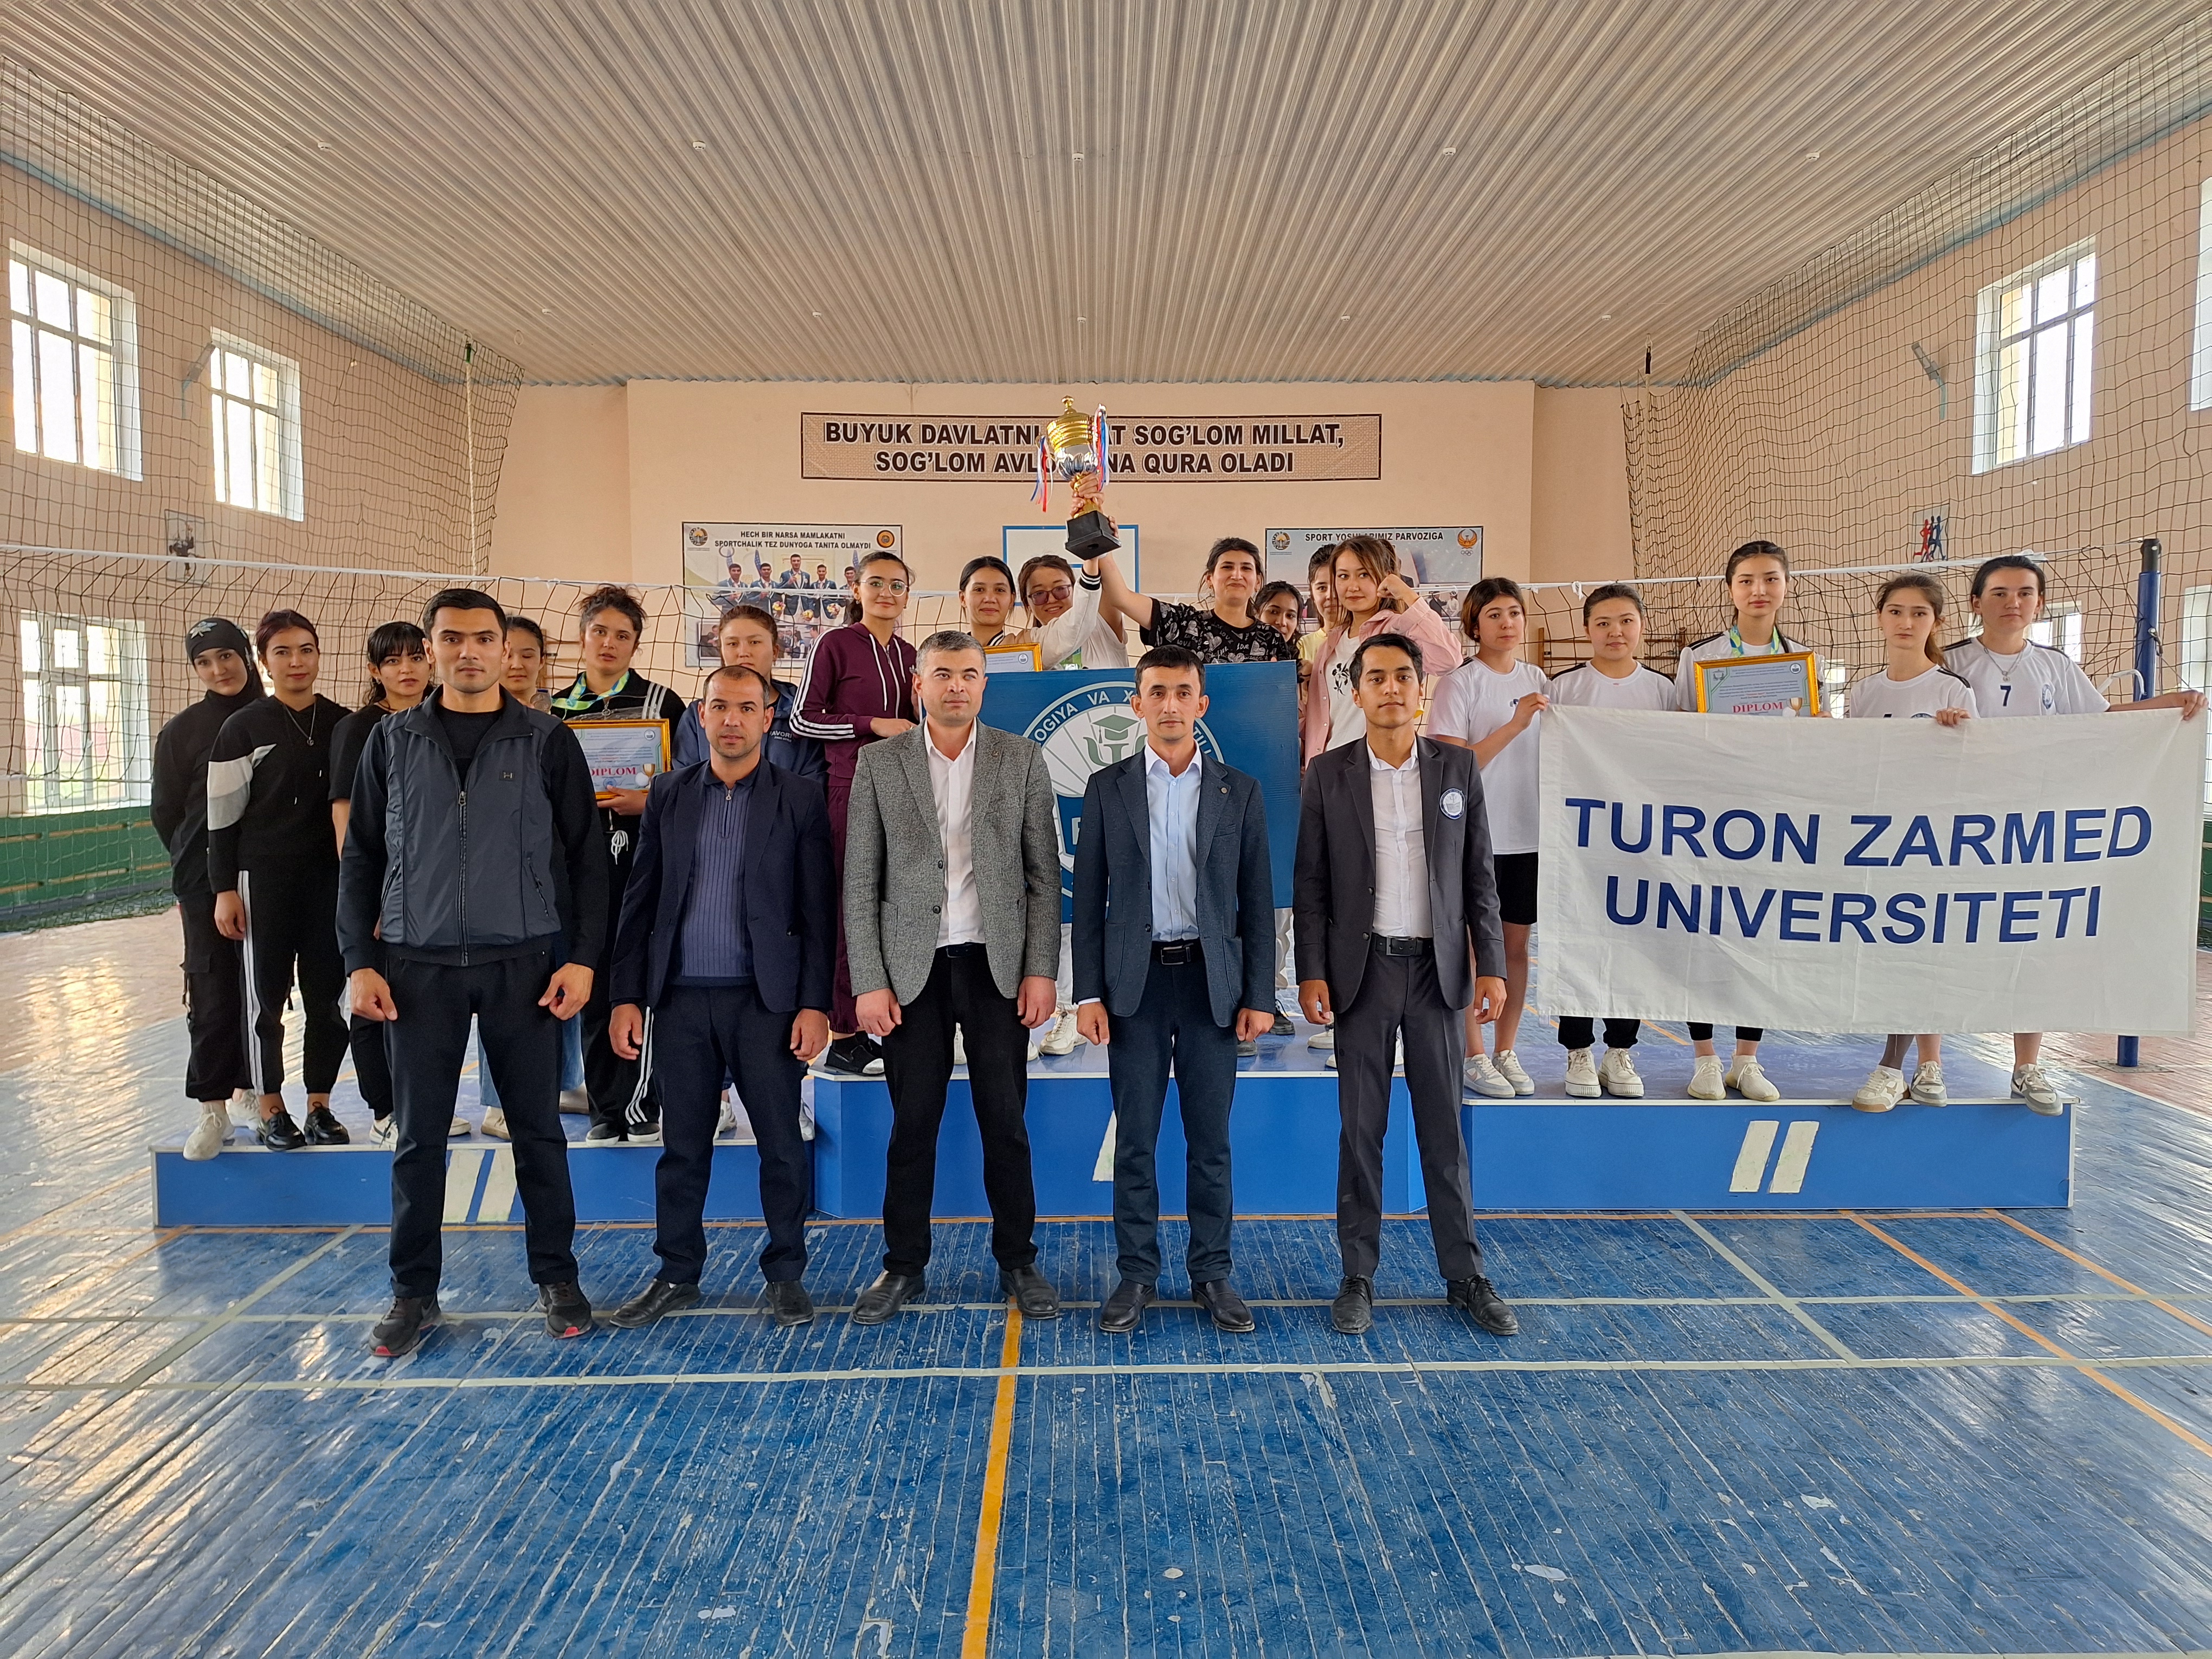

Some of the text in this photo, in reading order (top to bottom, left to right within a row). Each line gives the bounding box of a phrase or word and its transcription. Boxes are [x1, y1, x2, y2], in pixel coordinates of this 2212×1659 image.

[824, 422, 912, 443] BUYUK
[919, 424, 1040, 445] DAVLATNI
[1133, 425, 1243, 445] SOG'LOM
[1251, 423, 1343, 448] MILLAT,
[876, 451, 985, 472] SOG'LOM
[1142, 453, 1213, 475] QURA
[1219, 452, 1293, 473] OLADI
[1396, 532, 1444, 541] PARVOZIGA
[1087, 691, 1110, 705] VA
[2000, 685, 2011, 706] 7
[1733, 702, 1783, 713] DIPLOM
[1565, 798, 2152, 867] TURON ZARMED
[1605, 875, 2101, 944] UNIVERSITETI
